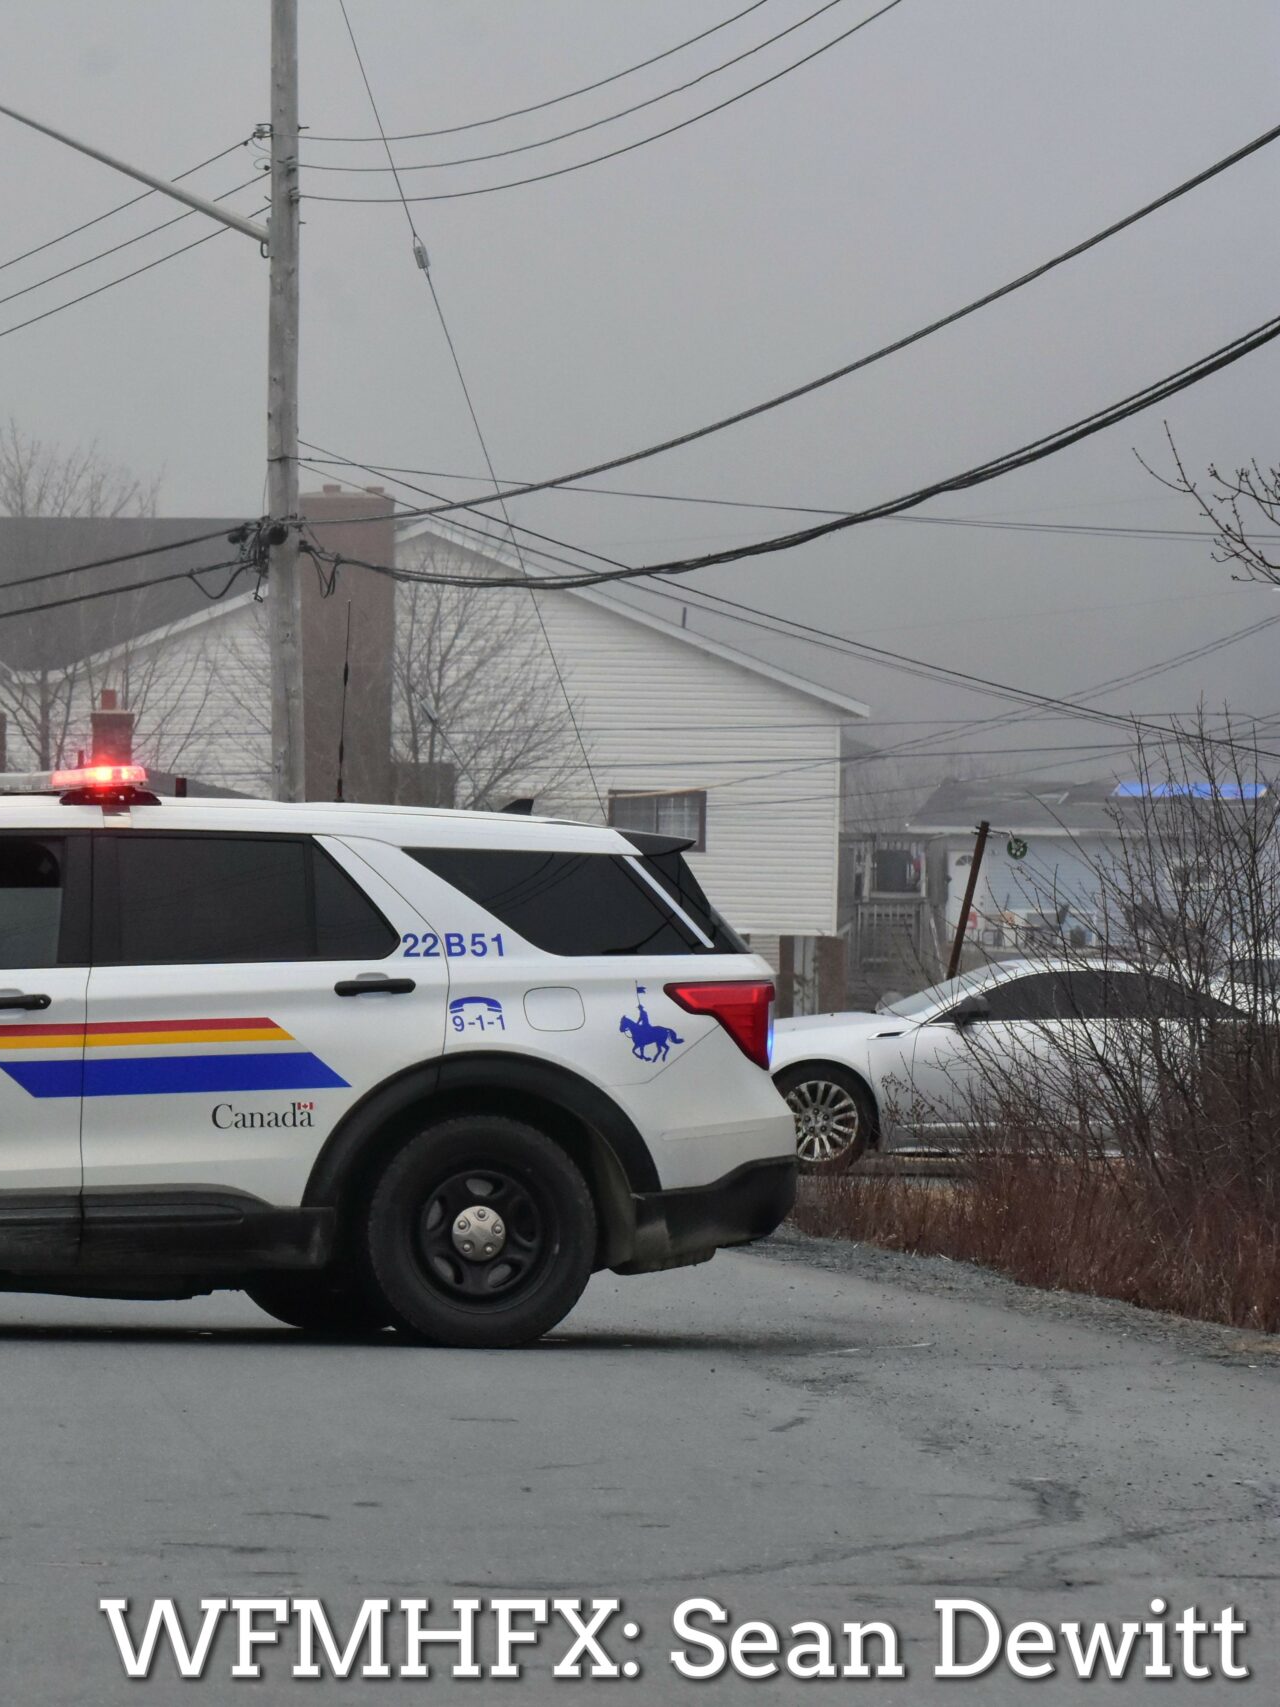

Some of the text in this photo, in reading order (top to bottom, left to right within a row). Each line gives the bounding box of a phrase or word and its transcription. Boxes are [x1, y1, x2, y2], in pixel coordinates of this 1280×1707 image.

[401, 932, 504, 958] 22B51
[451, 1014, 506, 1033] 9-1-1
[211, 1102, 315, 1130] Canada
